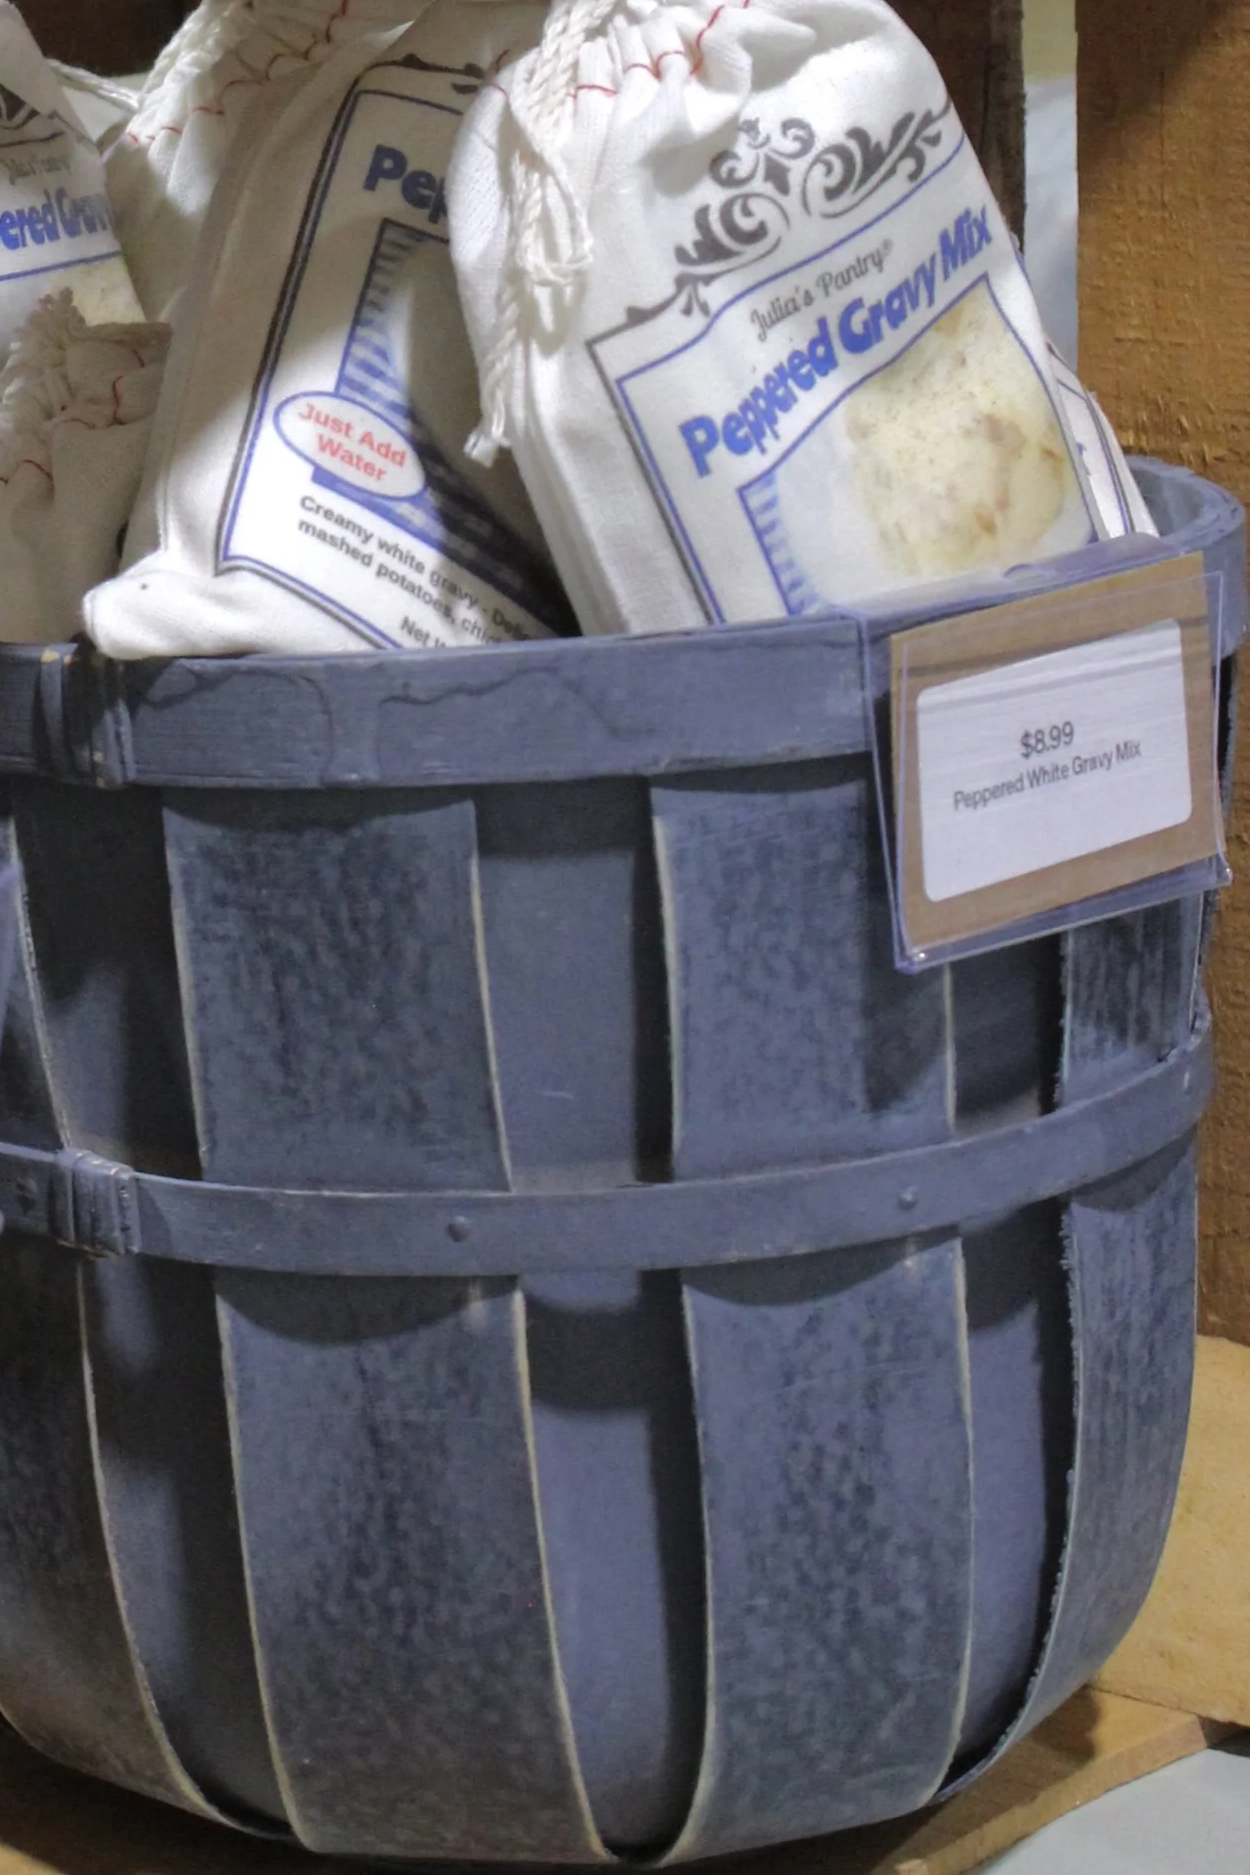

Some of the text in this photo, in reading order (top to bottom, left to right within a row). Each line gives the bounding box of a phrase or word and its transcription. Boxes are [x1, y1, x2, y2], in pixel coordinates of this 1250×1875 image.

[678, 205, 993, 479] Peppered Gravy Mix
[749, 286, 816, 342] Julia's
[298, 402, 407, 468] Just Add
[317, 434, 388, 482] Water
[297, 518, 374, 568] mashed
[375, 557, 457, 626] potatoes,
[299, 494, 478, 608] Creamy white gravy
[400, 615, 432, 645] Net
[1020, 721, 1075, 760] $8.99
[953, 739, 1142, 813] Peppered White Gravy Mix
